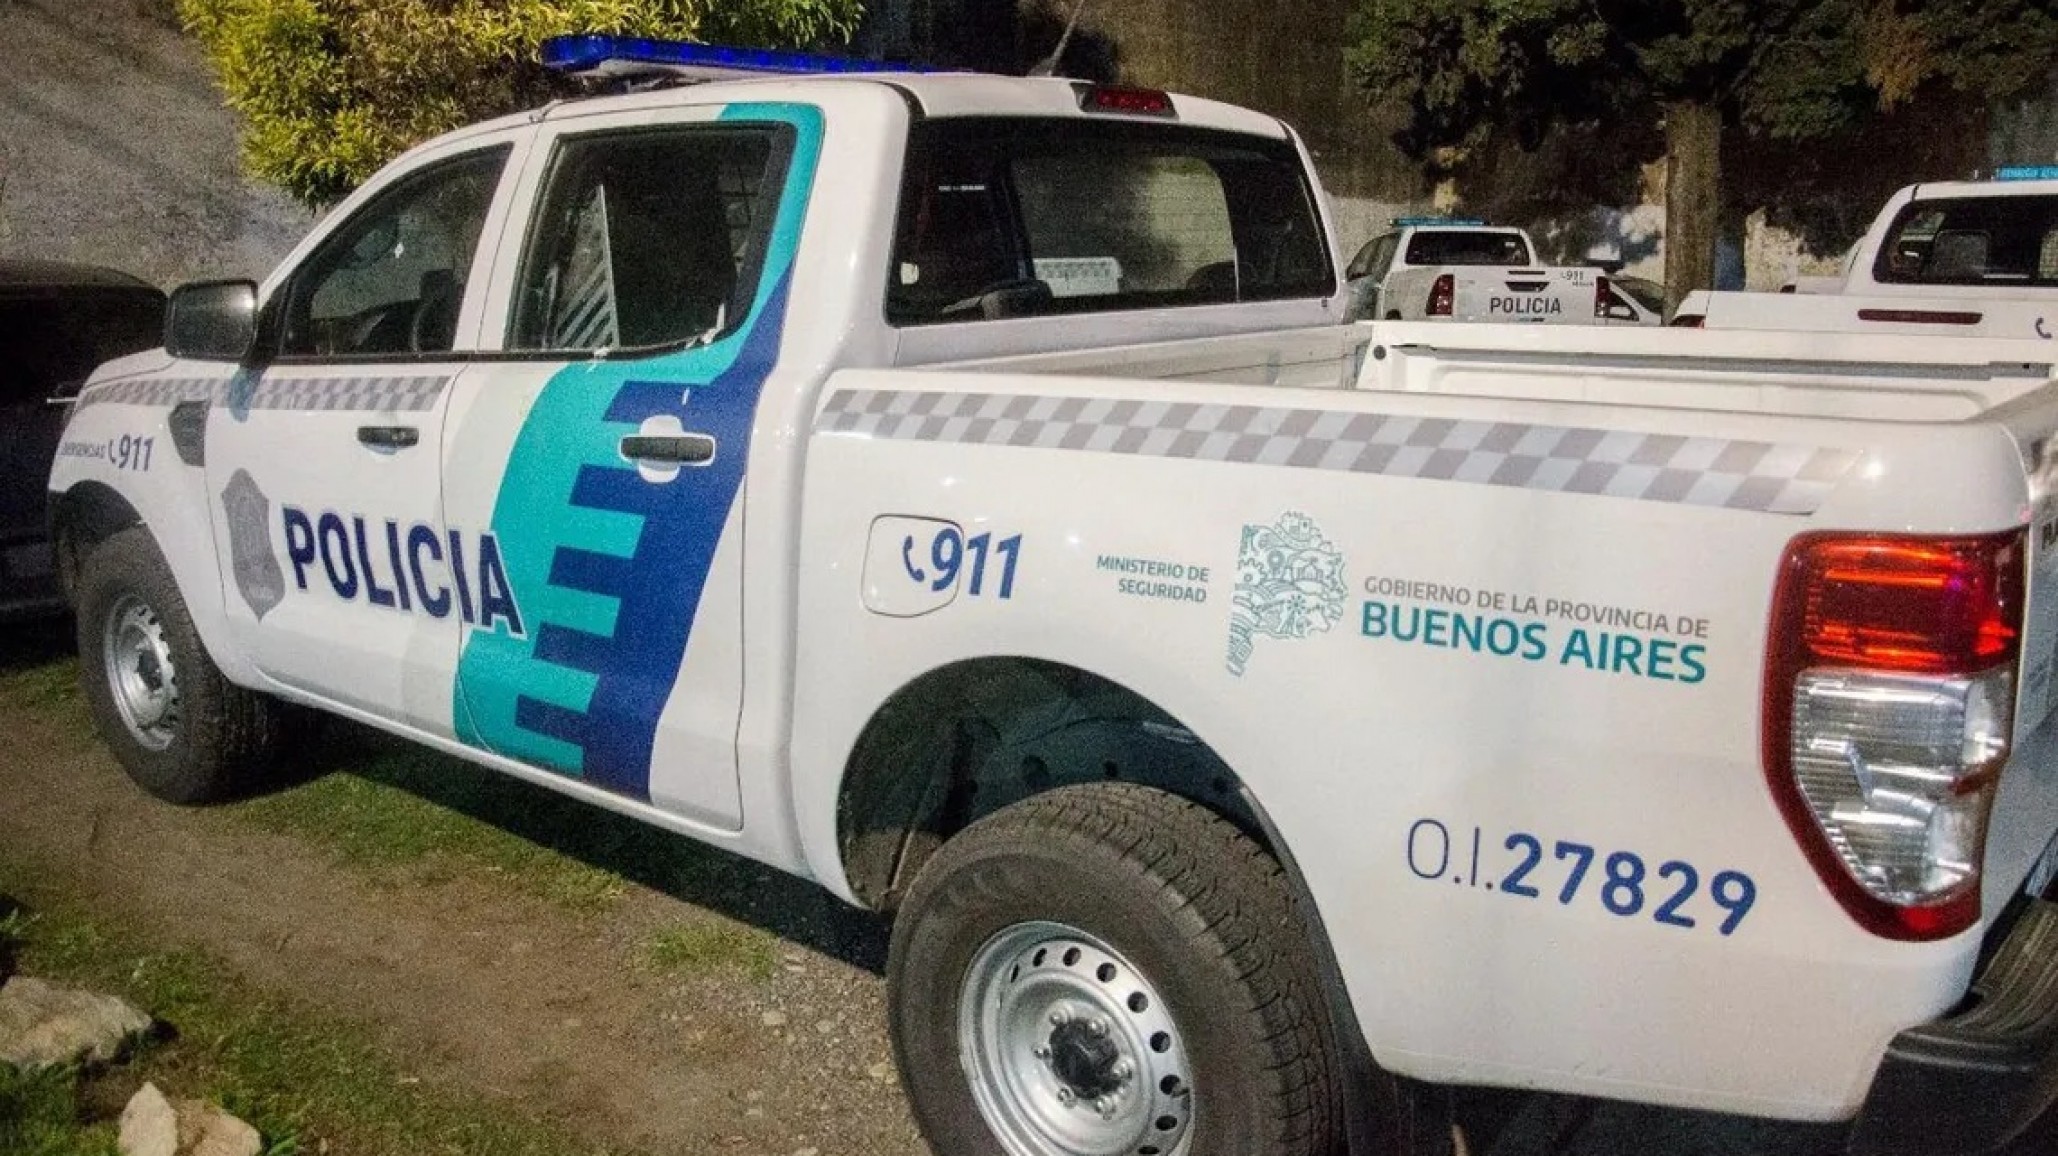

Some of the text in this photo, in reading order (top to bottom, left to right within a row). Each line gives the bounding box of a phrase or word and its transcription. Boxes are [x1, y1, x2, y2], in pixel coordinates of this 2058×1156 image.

[1490, 298, 1562, 314] POLICIA
[119, 434, 154, 471] 911
[283, 507, 524, 636] POLICIA
[931, 528, 1022, 599] 911
[1096, 555, 1210, 582] MINISTERIO DE
[1118, 578, 1207, 603] SEGURIDAD
[1364, 576, 1711, 638] GOBIERNO DE LA PROVINCIA DE
[1362, 601, 1708, 684] BUENOS AIRES
